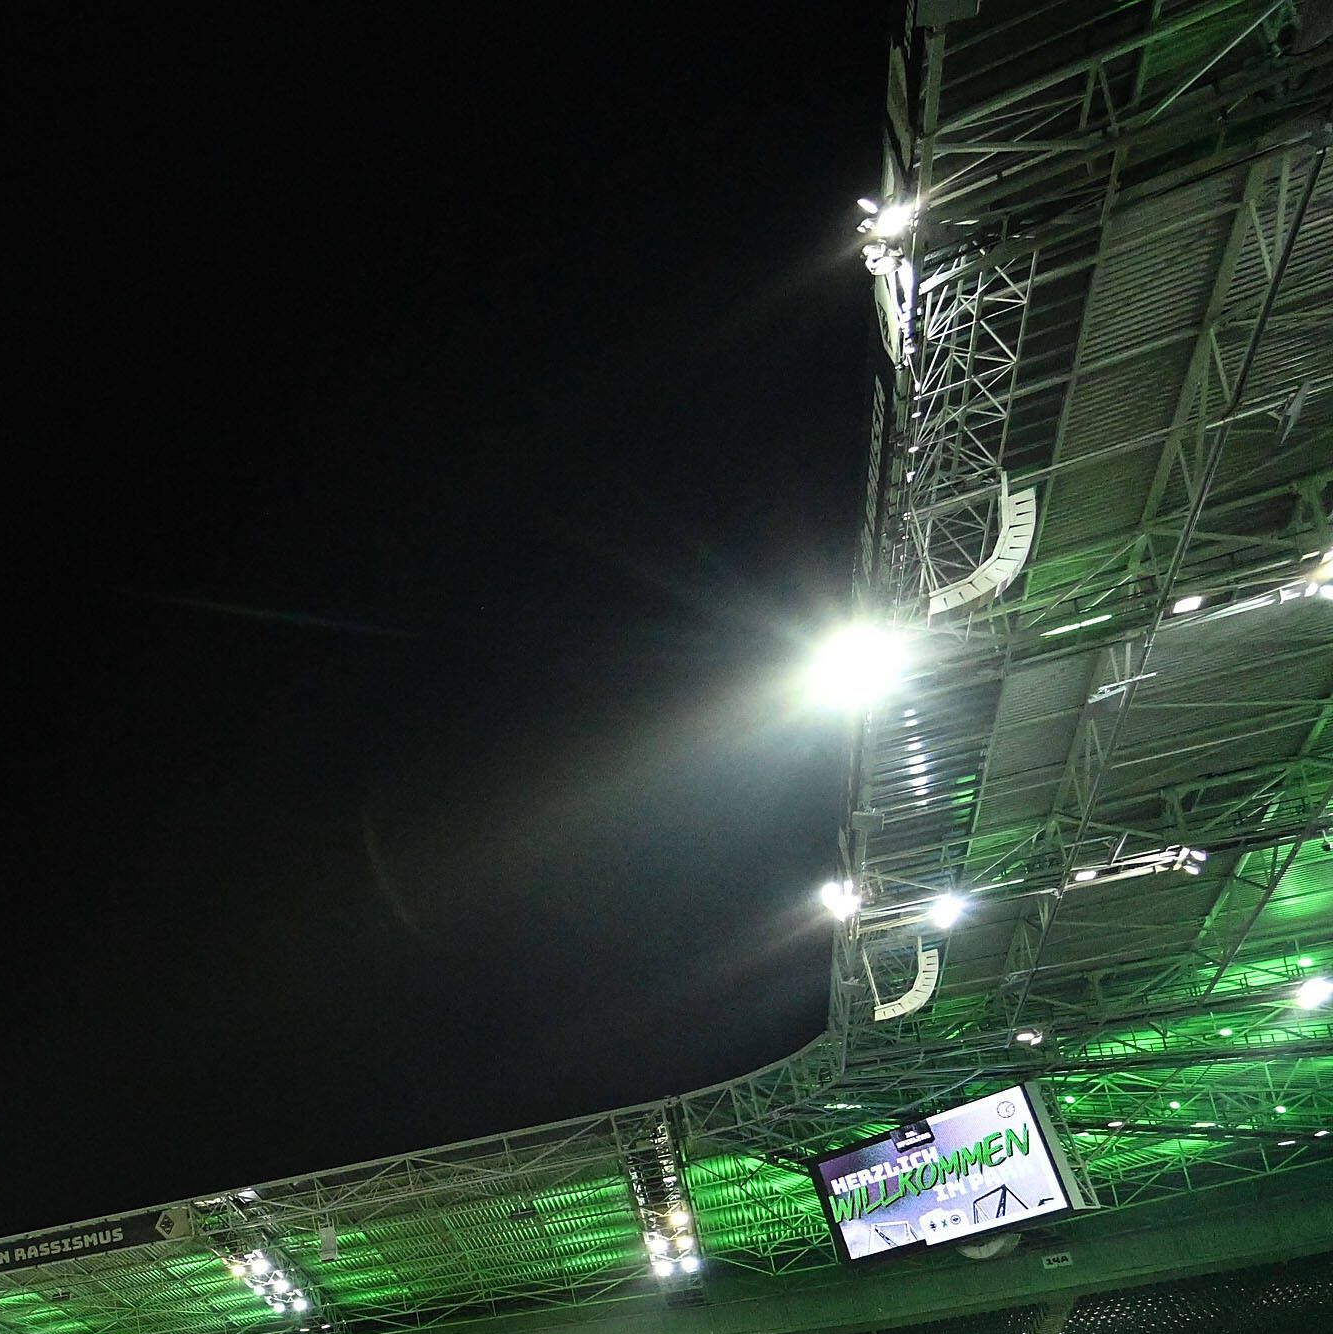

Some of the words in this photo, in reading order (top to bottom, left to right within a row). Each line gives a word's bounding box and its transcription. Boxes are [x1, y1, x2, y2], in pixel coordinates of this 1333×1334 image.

[829, 1123, 1030, 1223] WILLKOMMEN
[830, 1147, 940, 1195] HERZLICH
[935, 1175, 969, 1202] IM
[15, 1227, 124, 1263] RASSISMUS
[1045, 1256, 1069, 1266] 14A
